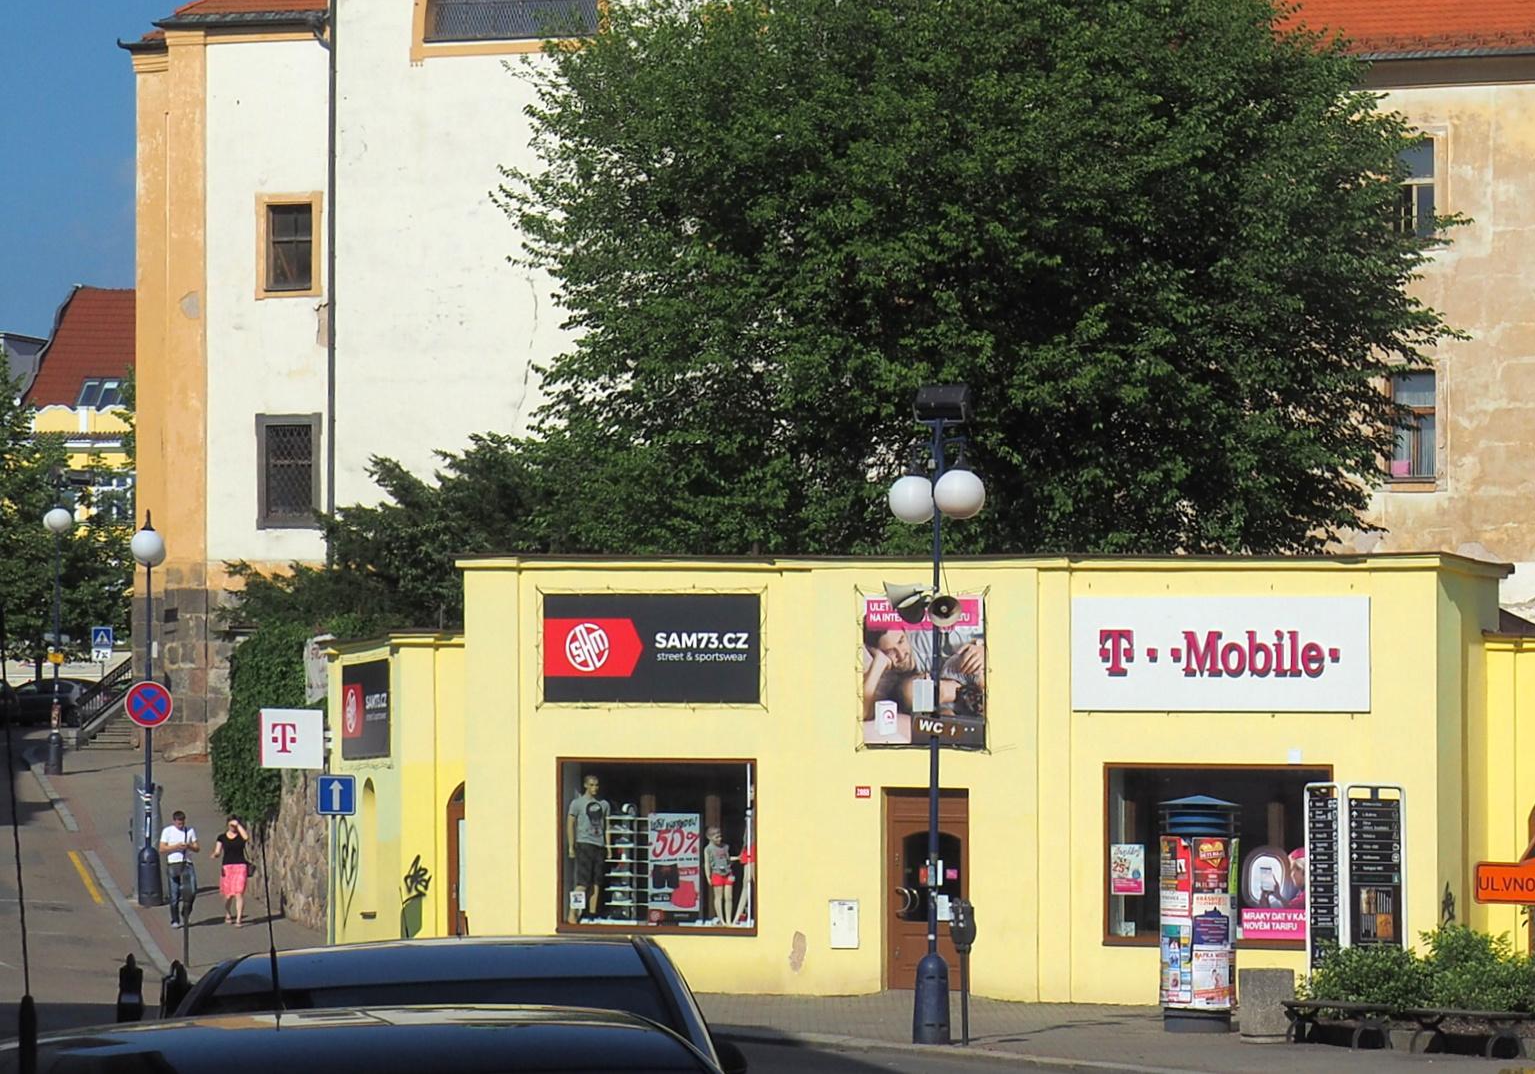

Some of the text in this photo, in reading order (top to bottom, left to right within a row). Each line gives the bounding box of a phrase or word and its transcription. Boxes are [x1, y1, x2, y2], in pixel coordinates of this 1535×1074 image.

[870, 613, 881, 622] NA
[655, 633, 749, 649] SAM73.CZ
[657, 652, 748, 664] street & sportswear
[919, 719, 944, 733] WC
[271, 723, 297, 753] T
[1243, 912, 1271, 921] MRAKY
[1271, 912, 1286, 921] DAT
[1243, 921, 1298, 931] NOVÉM TARIFU
